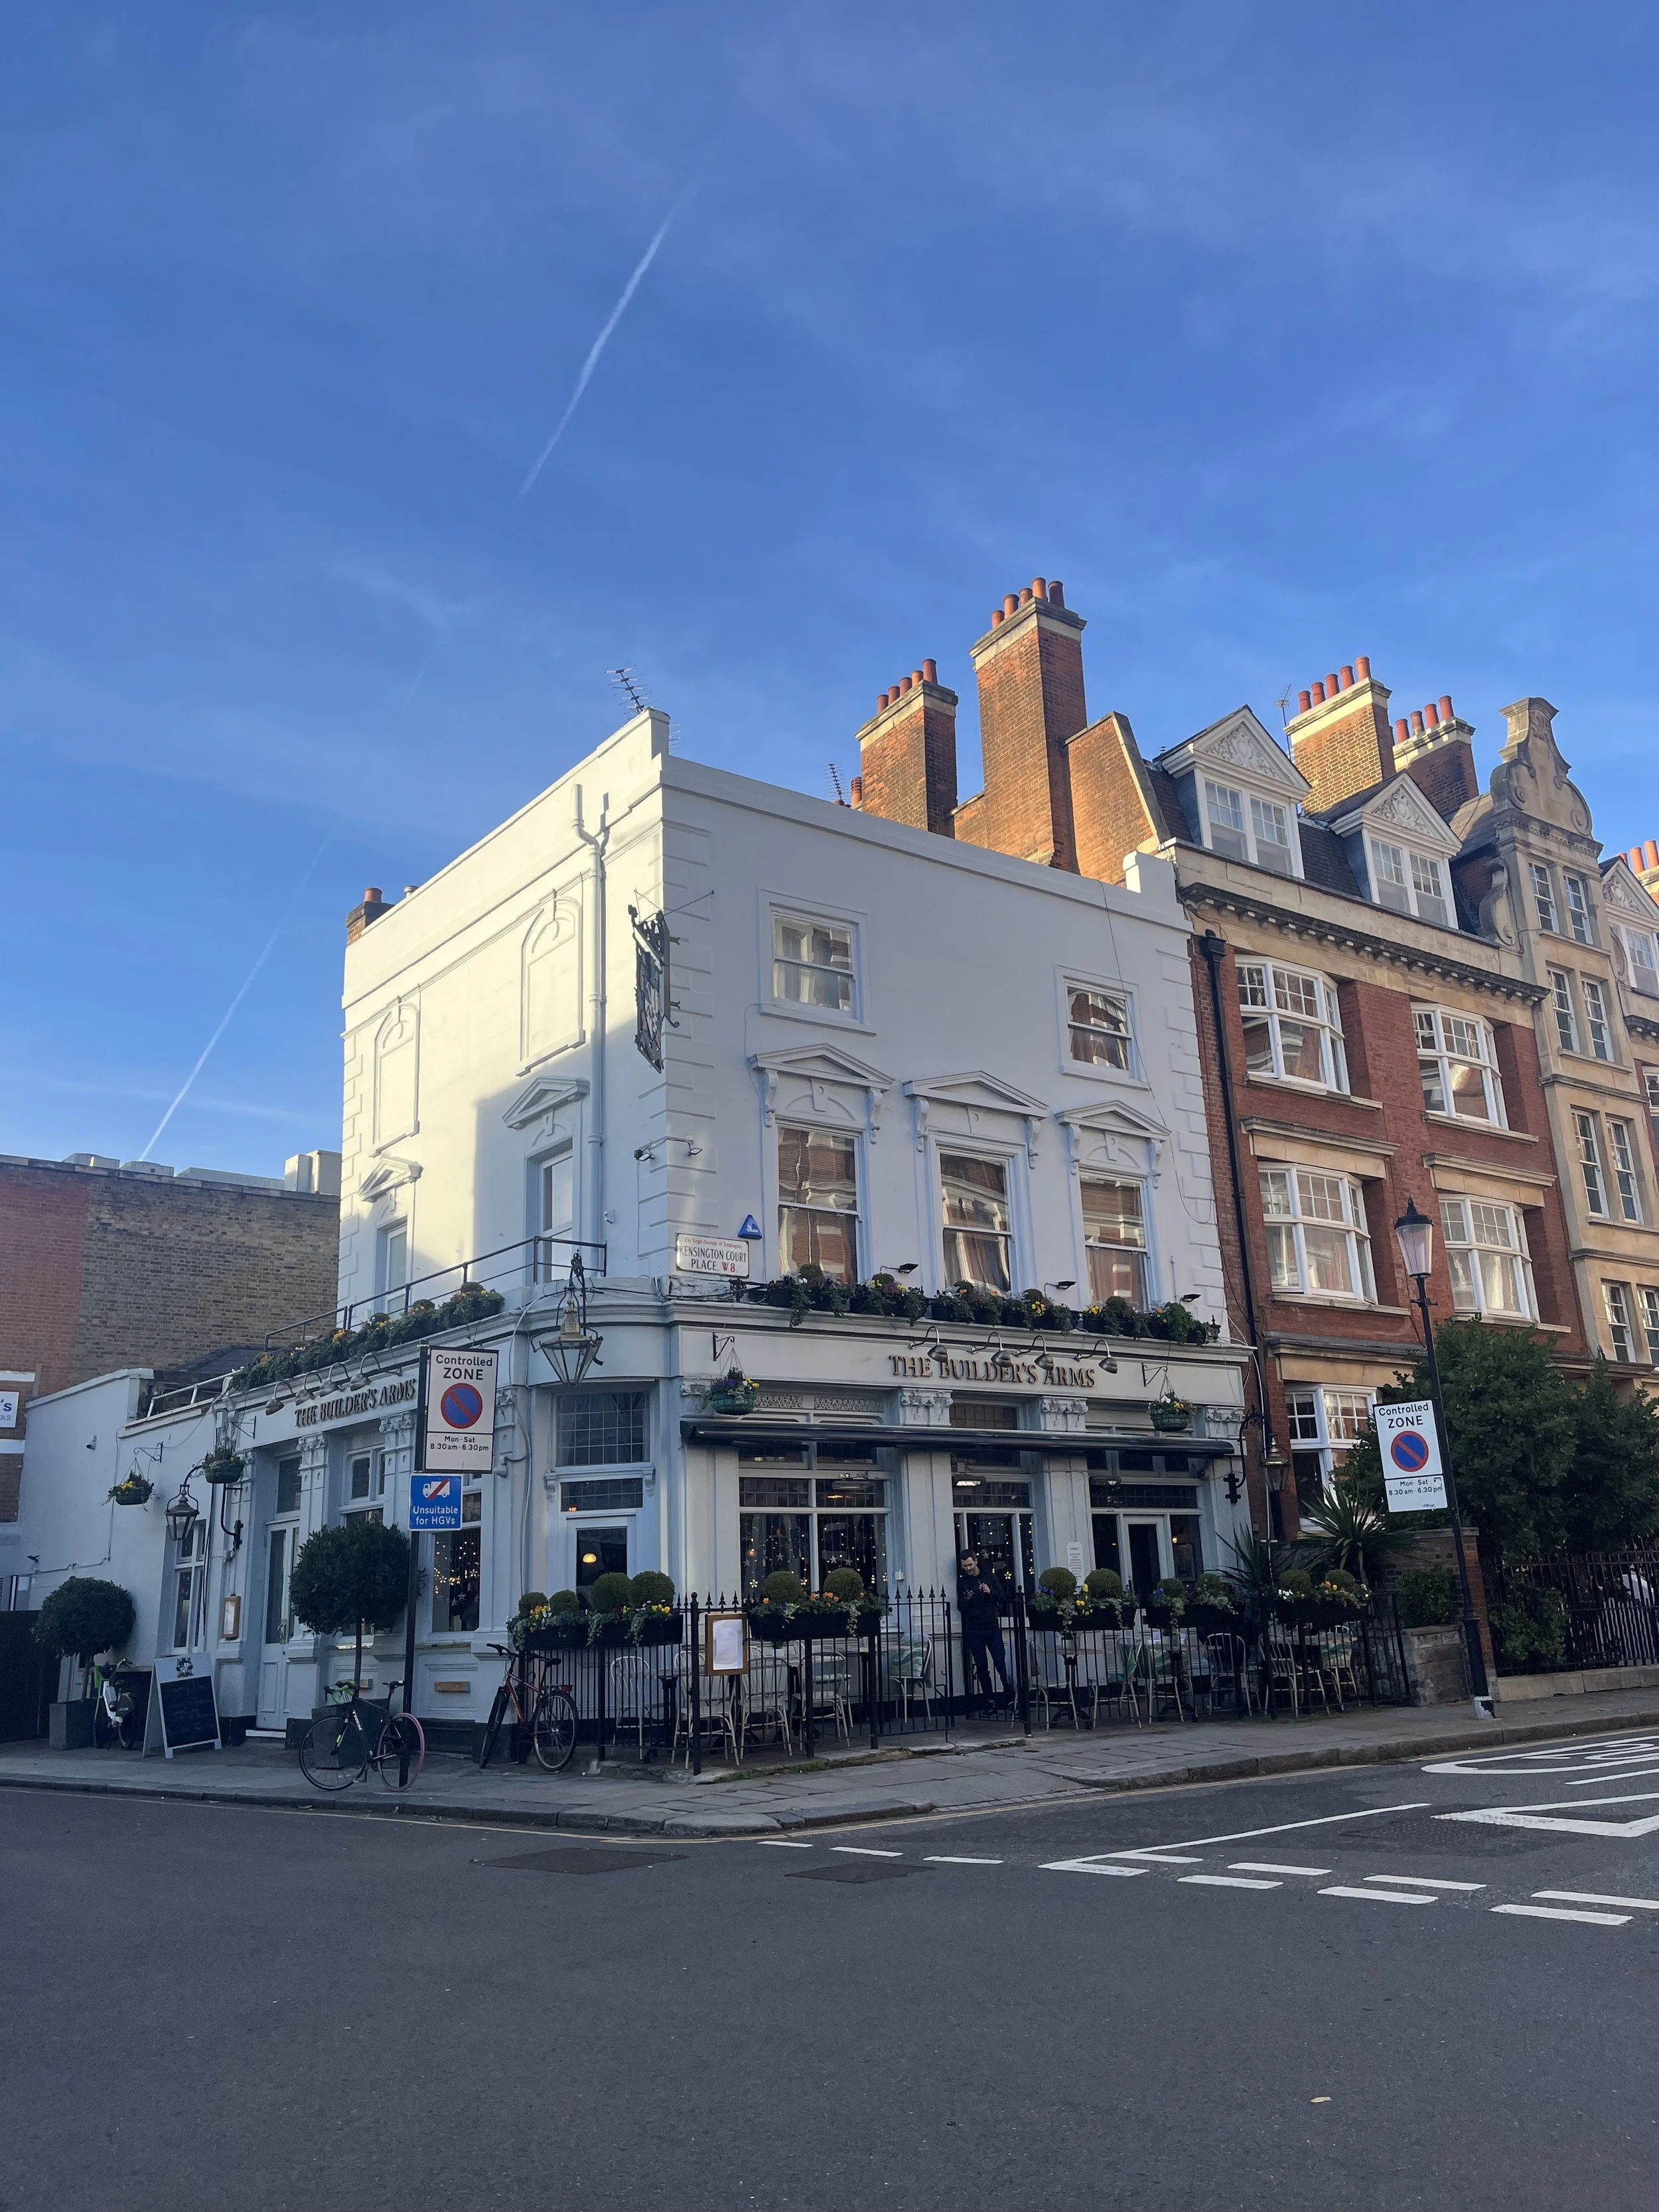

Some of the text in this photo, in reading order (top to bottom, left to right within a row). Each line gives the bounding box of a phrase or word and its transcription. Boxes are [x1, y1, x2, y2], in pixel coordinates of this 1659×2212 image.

[680, 1246, 747, 1262] KENSINGTON COURT
[436, 1355, 492, 1366] Controlled
[443, 1368, 484, 1380] ZONE
[889, 1355, 1096, 1388] THE BUILDER'S ARMS
[295, 1378, 417, 1428] THE BUILDER'S ARMS
[1379, 1402, 1429, 1416] Controlled
[1388, 1416, 1423, 1428] ZONE
[413, 1505, 458, 1514] Unsuitable
[415, 1516, 455, 1525] for HGVs
